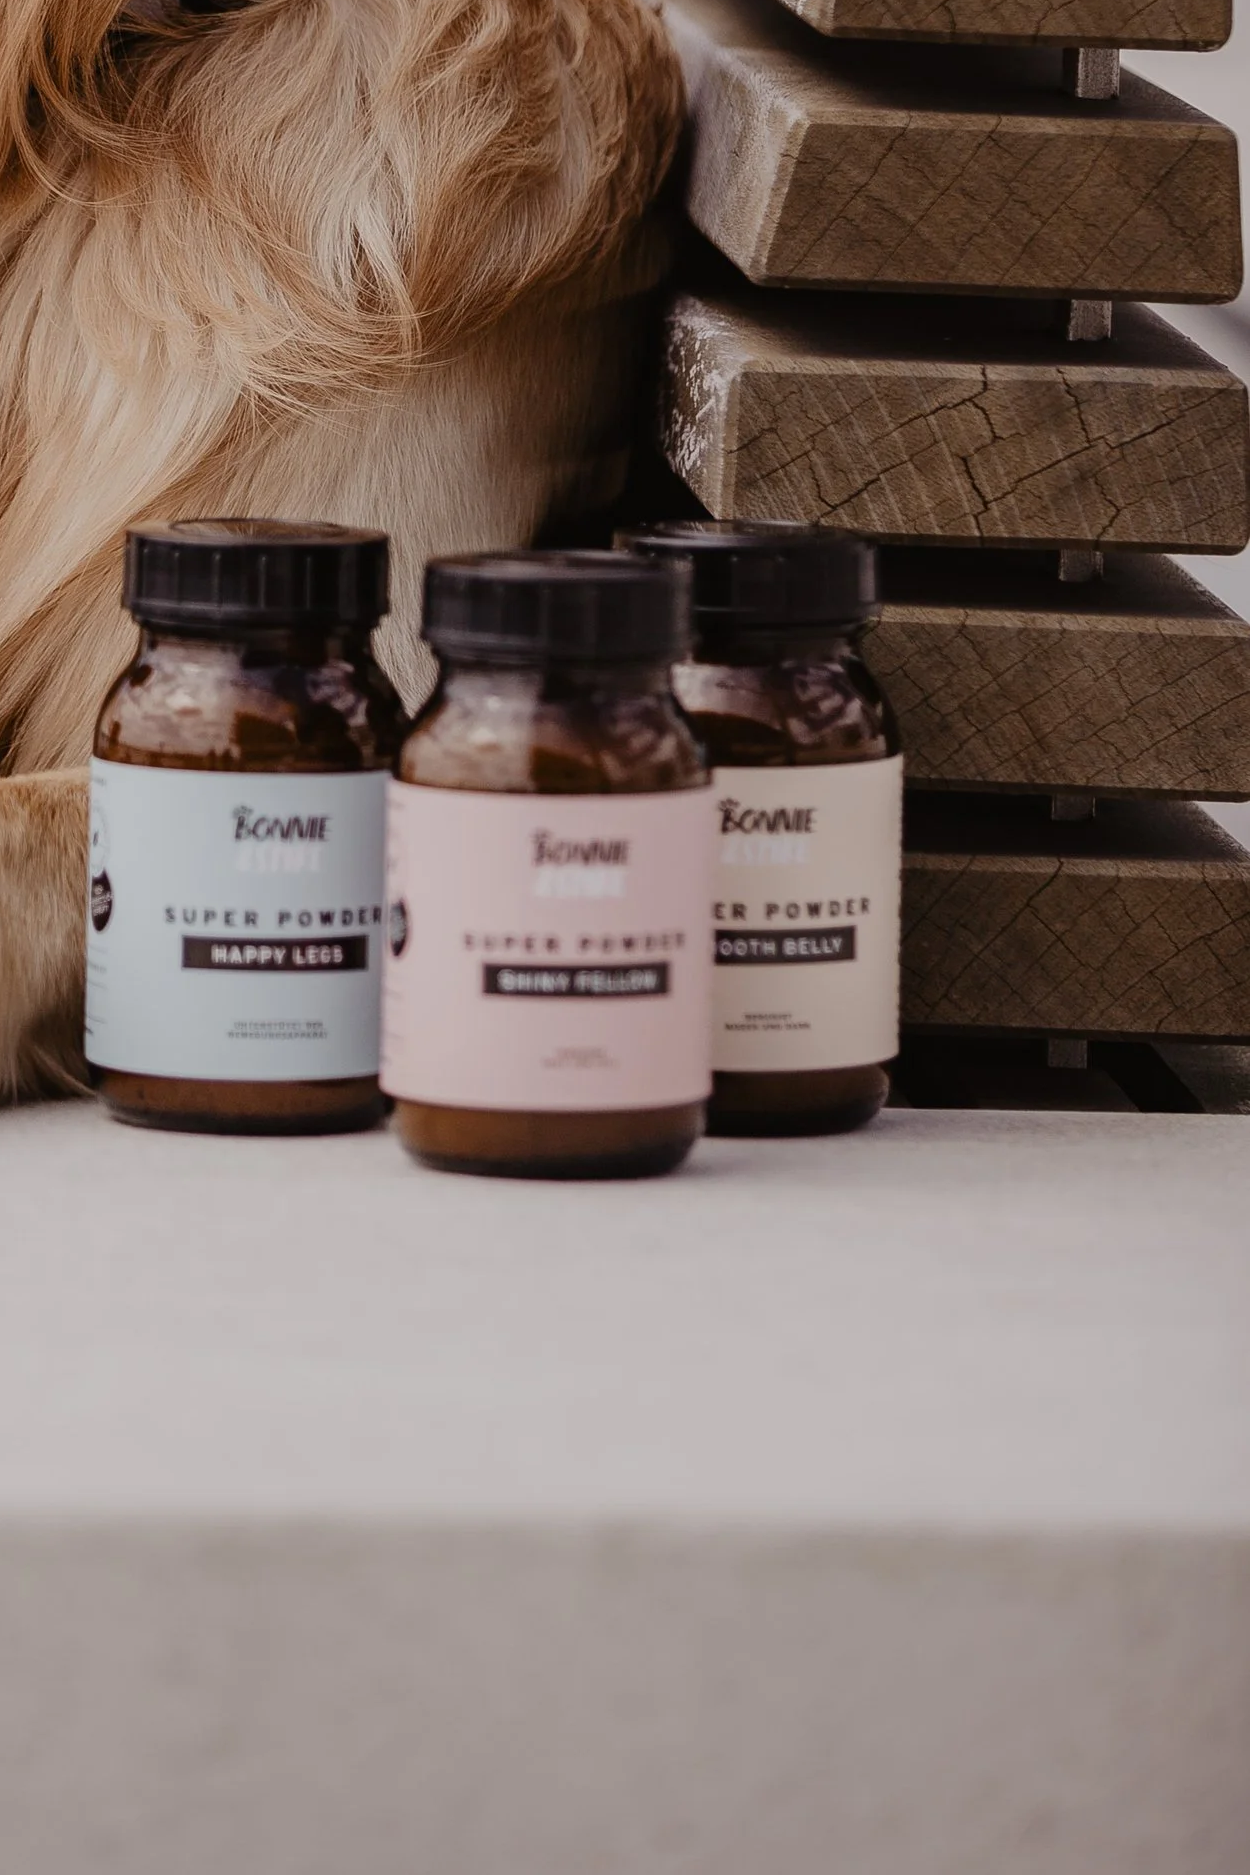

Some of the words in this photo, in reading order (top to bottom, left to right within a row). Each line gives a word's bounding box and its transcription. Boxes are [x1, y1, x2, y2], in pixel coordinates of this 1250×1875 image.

[235, 814, 331, 842] BONNIE
[720, 805, 816, 835] BONNIE
[165, 906, 259, 927] SUPER
[278, 905, 382, 927] POWDER
[765, 897, 871, 920] POWDER
[211, 943, 286, 964] HAPPY
[292, 944, 343, 964] LEGS
[717, 938, 776, 956] OOTH
[782, 936, 843, 956] BELLY
